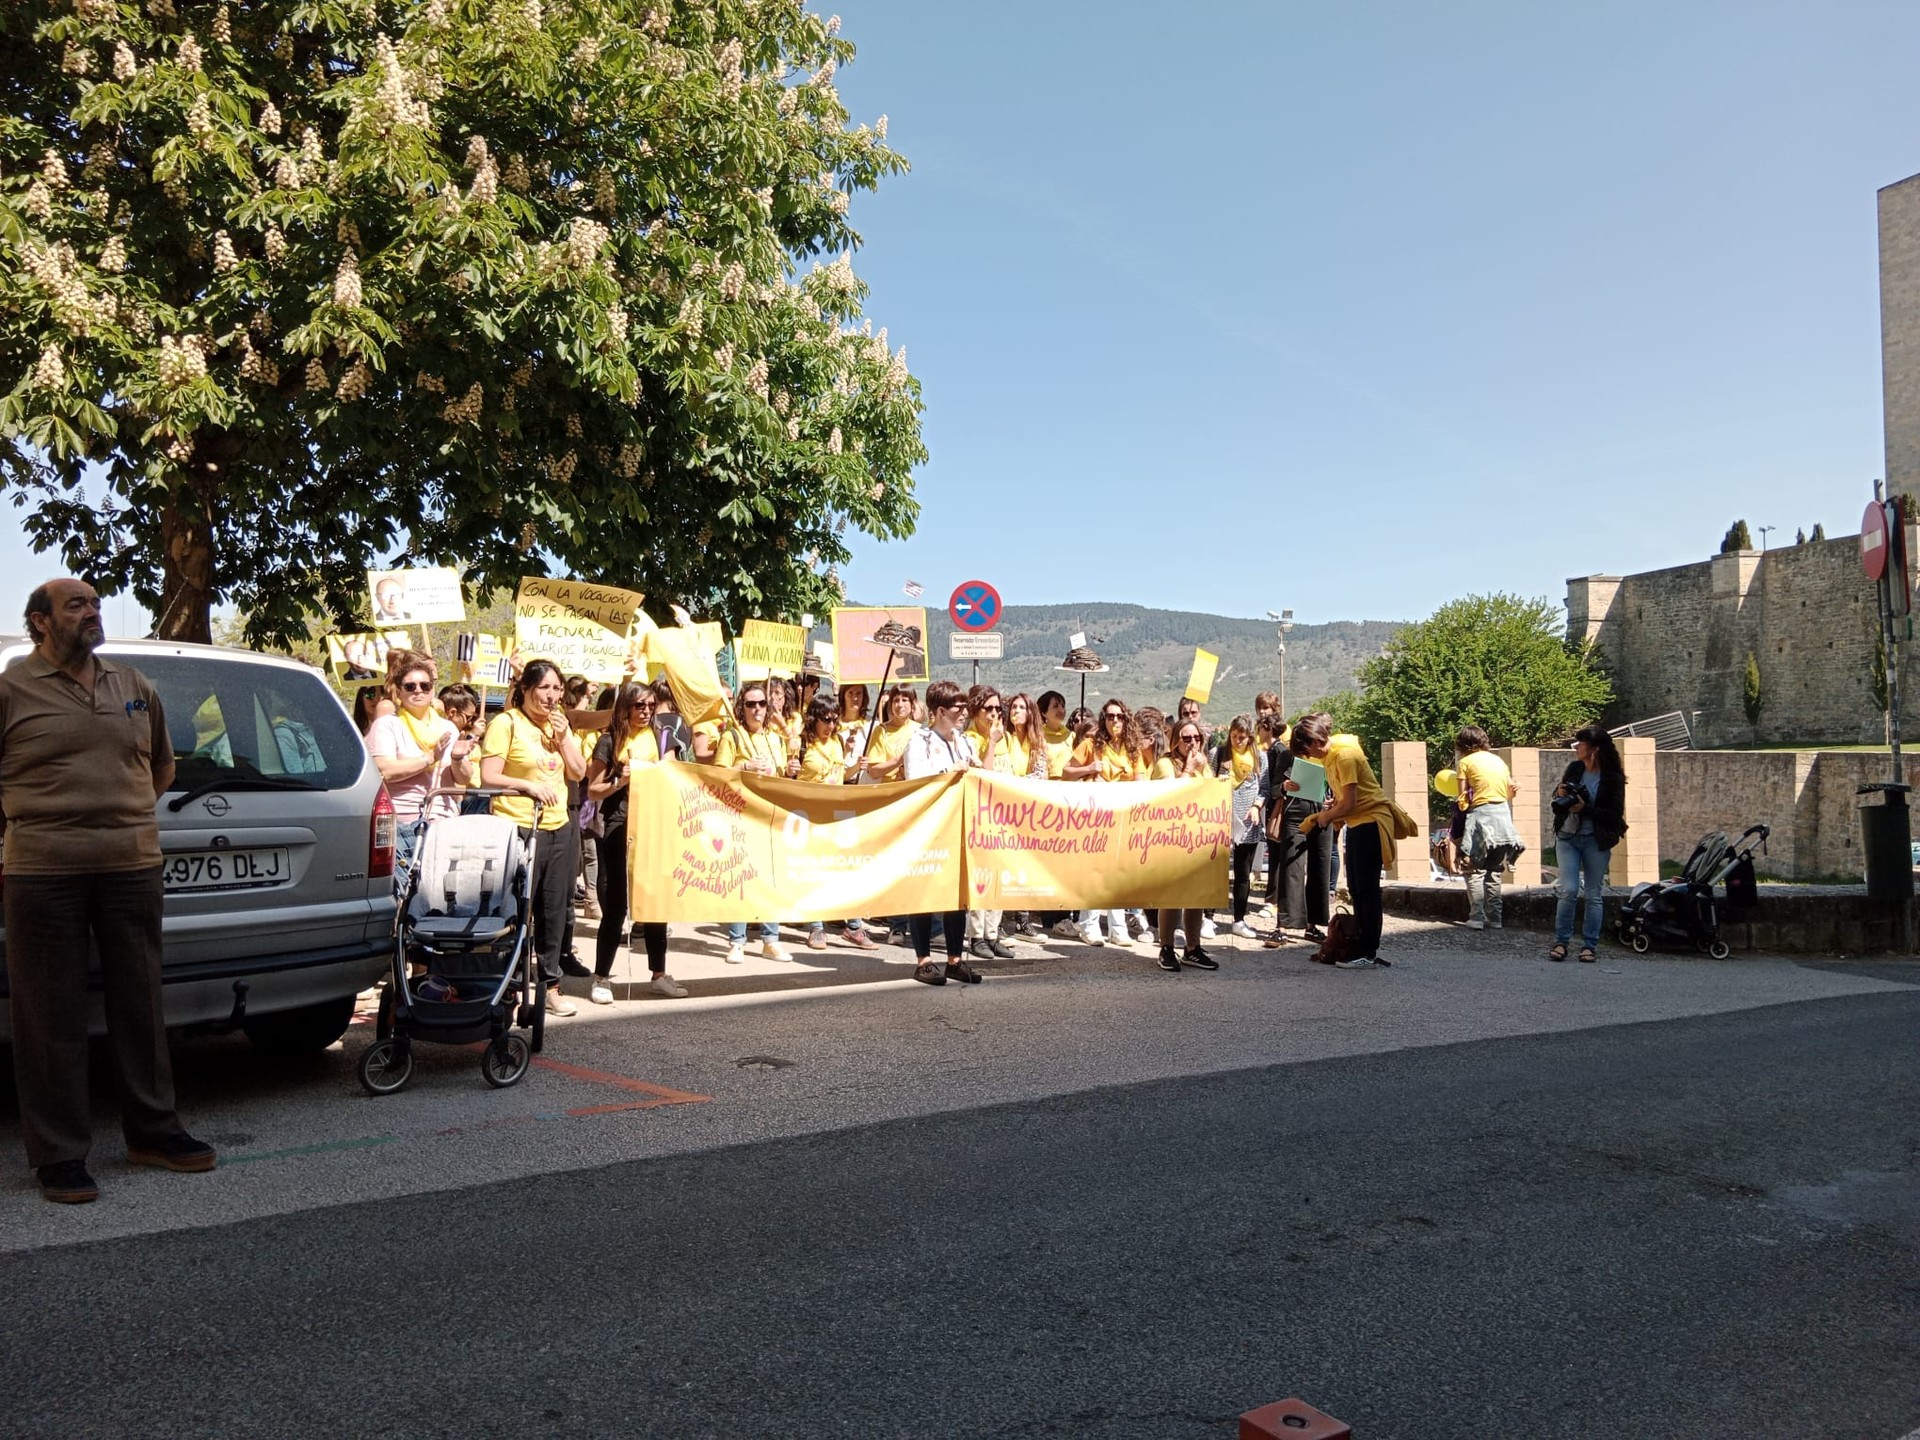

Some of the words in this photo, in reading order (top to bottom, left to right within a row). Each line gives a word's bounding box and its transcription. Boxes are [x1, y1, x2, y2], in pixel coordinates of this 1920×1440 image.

[522, 582, 549, 597] CON
[556, 586, 570, 599] LA
[519, 604, 536, 618] NO
[541, 605, 556, 618] SE
[564, 605, 601, 621] PAGAN
[609, 608, 629, 625] LAS
[539, 625, 605, 641] FACTURAS
[519, 640, 577, 656] SALARIOS
[582, 643, 626, 656] DIGNOS
[1149, 806, 1184, 821] unas
[682, 820, 704, 838] alde
[730, 825, 747, 844] Por
[1082, 830, 1108, 854] alde
[1128, 822, 1194, 865] infantiles
[233, 852, 279, 879] DLJ
[682, 849, 706, 872] unas
[672, 864, 727, 899] infantiles
